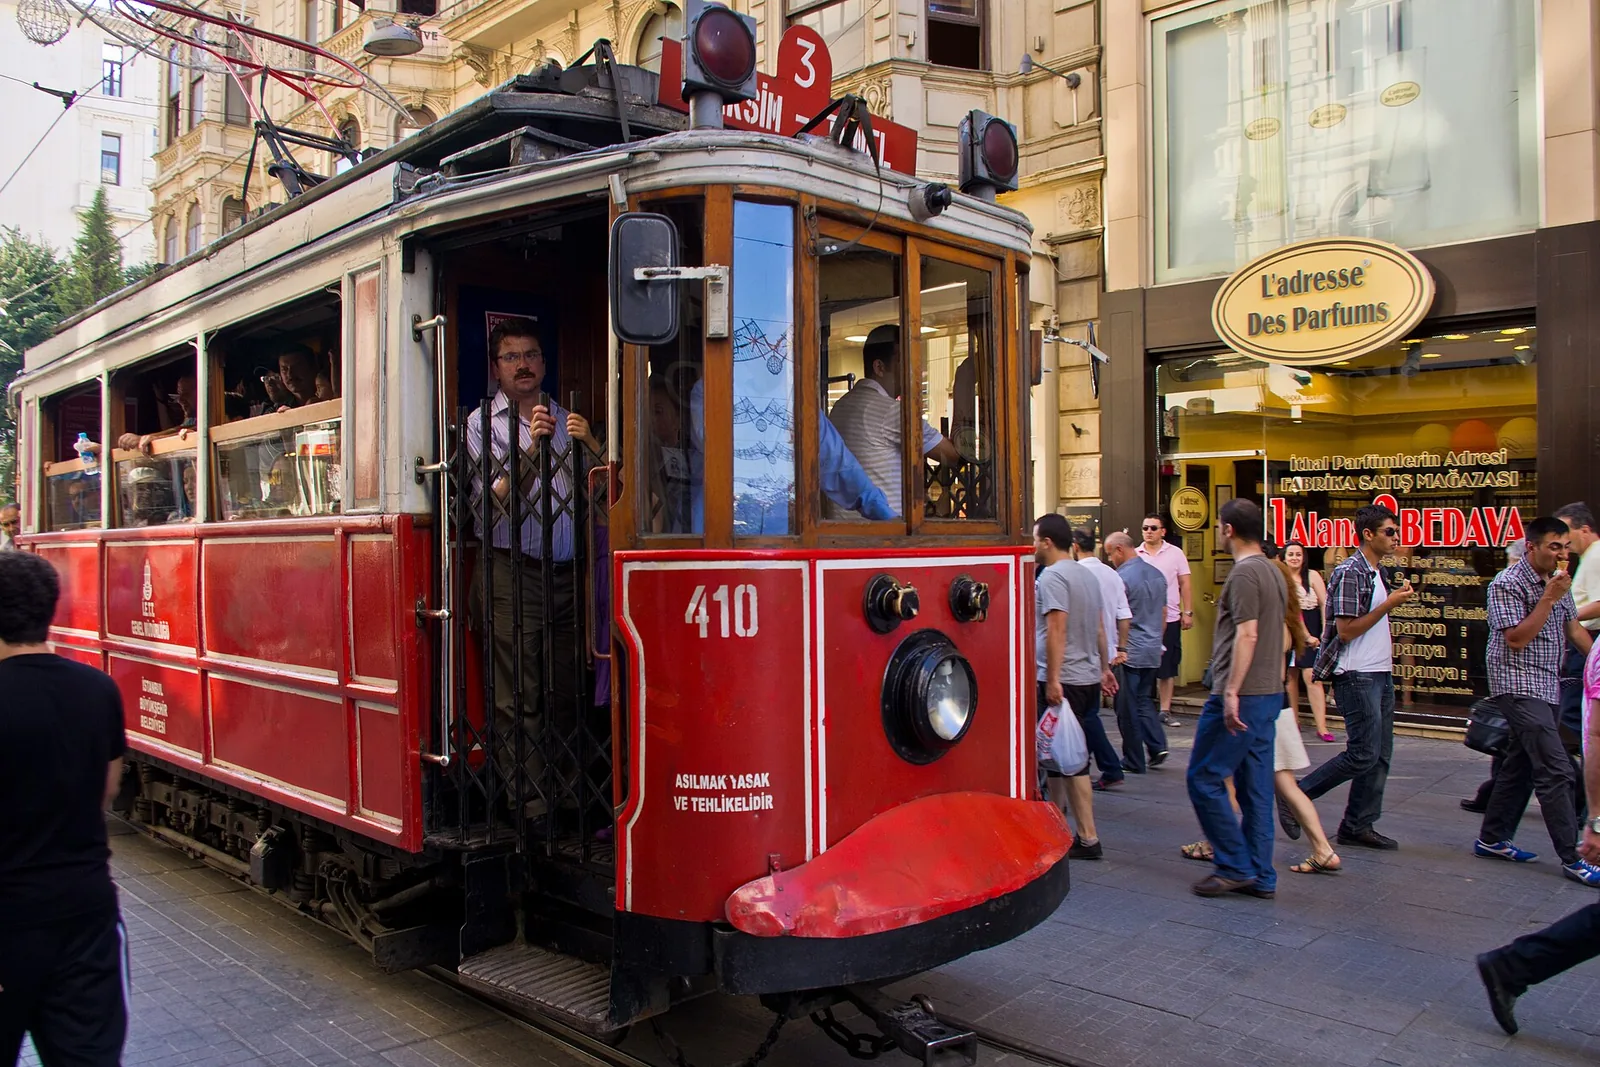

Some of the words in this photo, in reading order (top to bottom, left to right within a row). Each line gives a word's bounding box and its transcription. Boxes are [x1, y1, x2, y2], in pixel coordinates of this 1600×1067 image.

[794, 37, 816, 89] 3
[1261, 265, 1364, 299] L'adresse
[1247, 311, 1287, 337] Des
[1292, 301, 1390, 332] Parfums
[1289, 454, 1329, 472] İthal
[1332, 452, 1441, 471] Parfümlerin
[1443, 448, 1508, 467] Adresi
[1280, 473, 1356, 492] FABRİKA
[1358, 474, 1413, 494] SATIŞ
[1416, 469, 1519, 489] MAĞAZASI
[1400, 506, 1525, 548] BEDAVA
[1399, 556, 1409, 568] 2
[1411, 555, 1433, 568] For
[1435, 555, 1465, 568] Free
[684, 584, 759, 638] 410
[675, 773, 727, 790] ASILMAK
[729, 772, 770, 790] YASAK
[673, 796, 688, 811] VE
[690, 791, 774, 813] TEHLİKELİDİR
